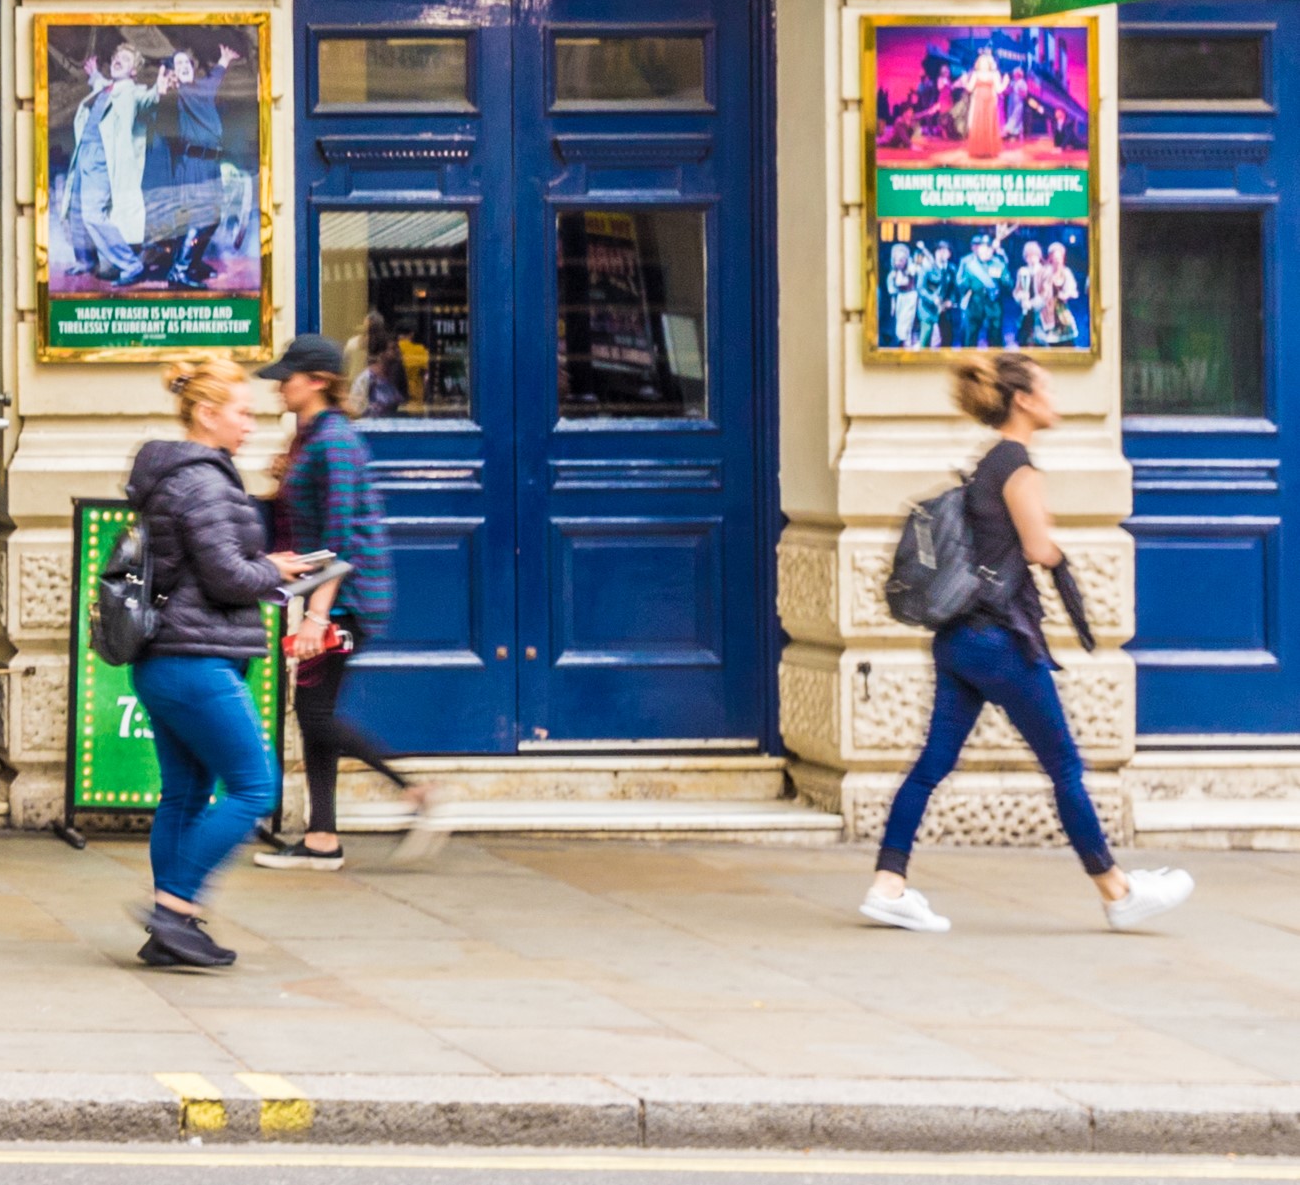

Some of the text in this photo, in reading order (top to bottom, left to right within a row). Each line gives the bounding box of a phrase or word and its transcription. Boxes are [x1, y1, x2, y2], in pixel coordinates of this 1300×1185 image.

[115, 307, 150, 320] FRASER
[151, 307, 160, 319] IS
[212, 306, 233, 319] AND
[58, 321, 110, 334] TIRELESSLY
[111, 321, 166, 334] EXUBERANT
[167, 321, 179, 333] AS
